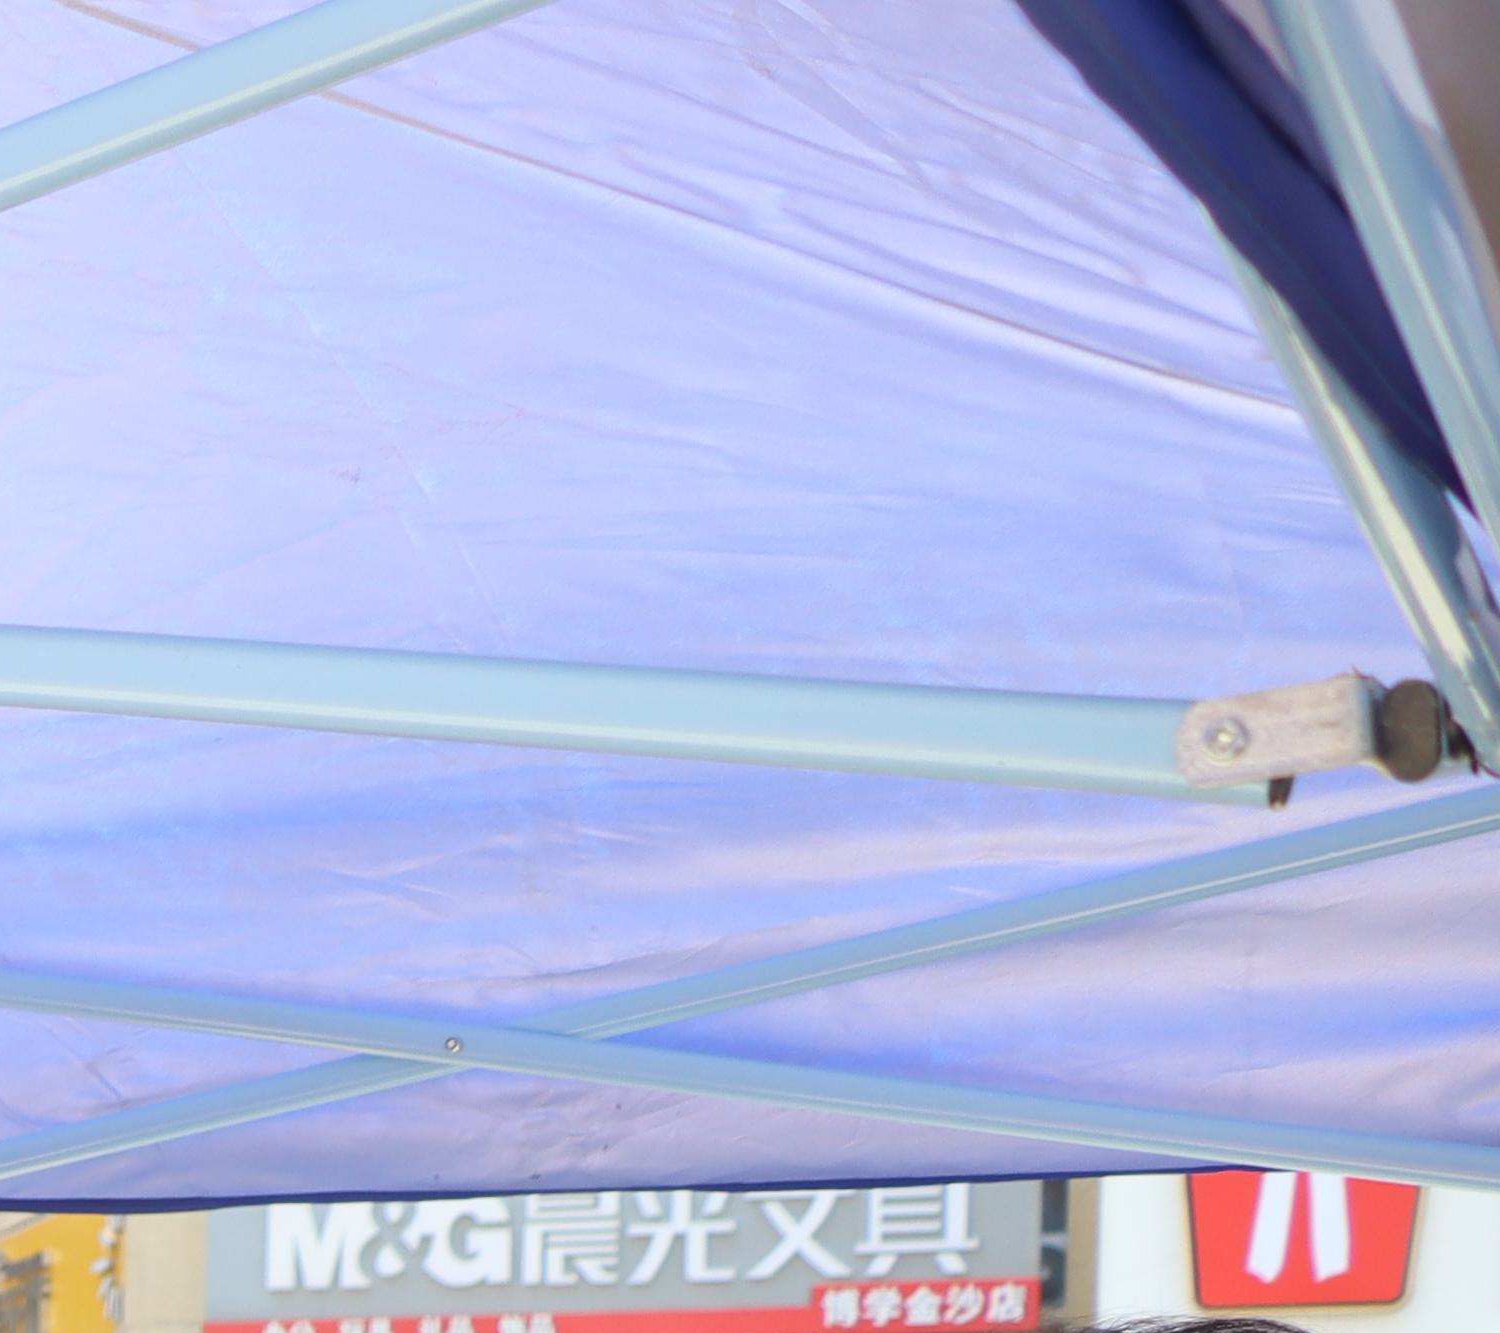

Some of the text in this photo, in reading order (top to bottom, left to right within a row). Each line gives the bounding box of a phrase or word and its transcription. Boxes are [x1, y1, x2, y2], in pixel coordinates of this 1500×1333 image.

[821, 1283, 1027, 1328] 博学金沙店
